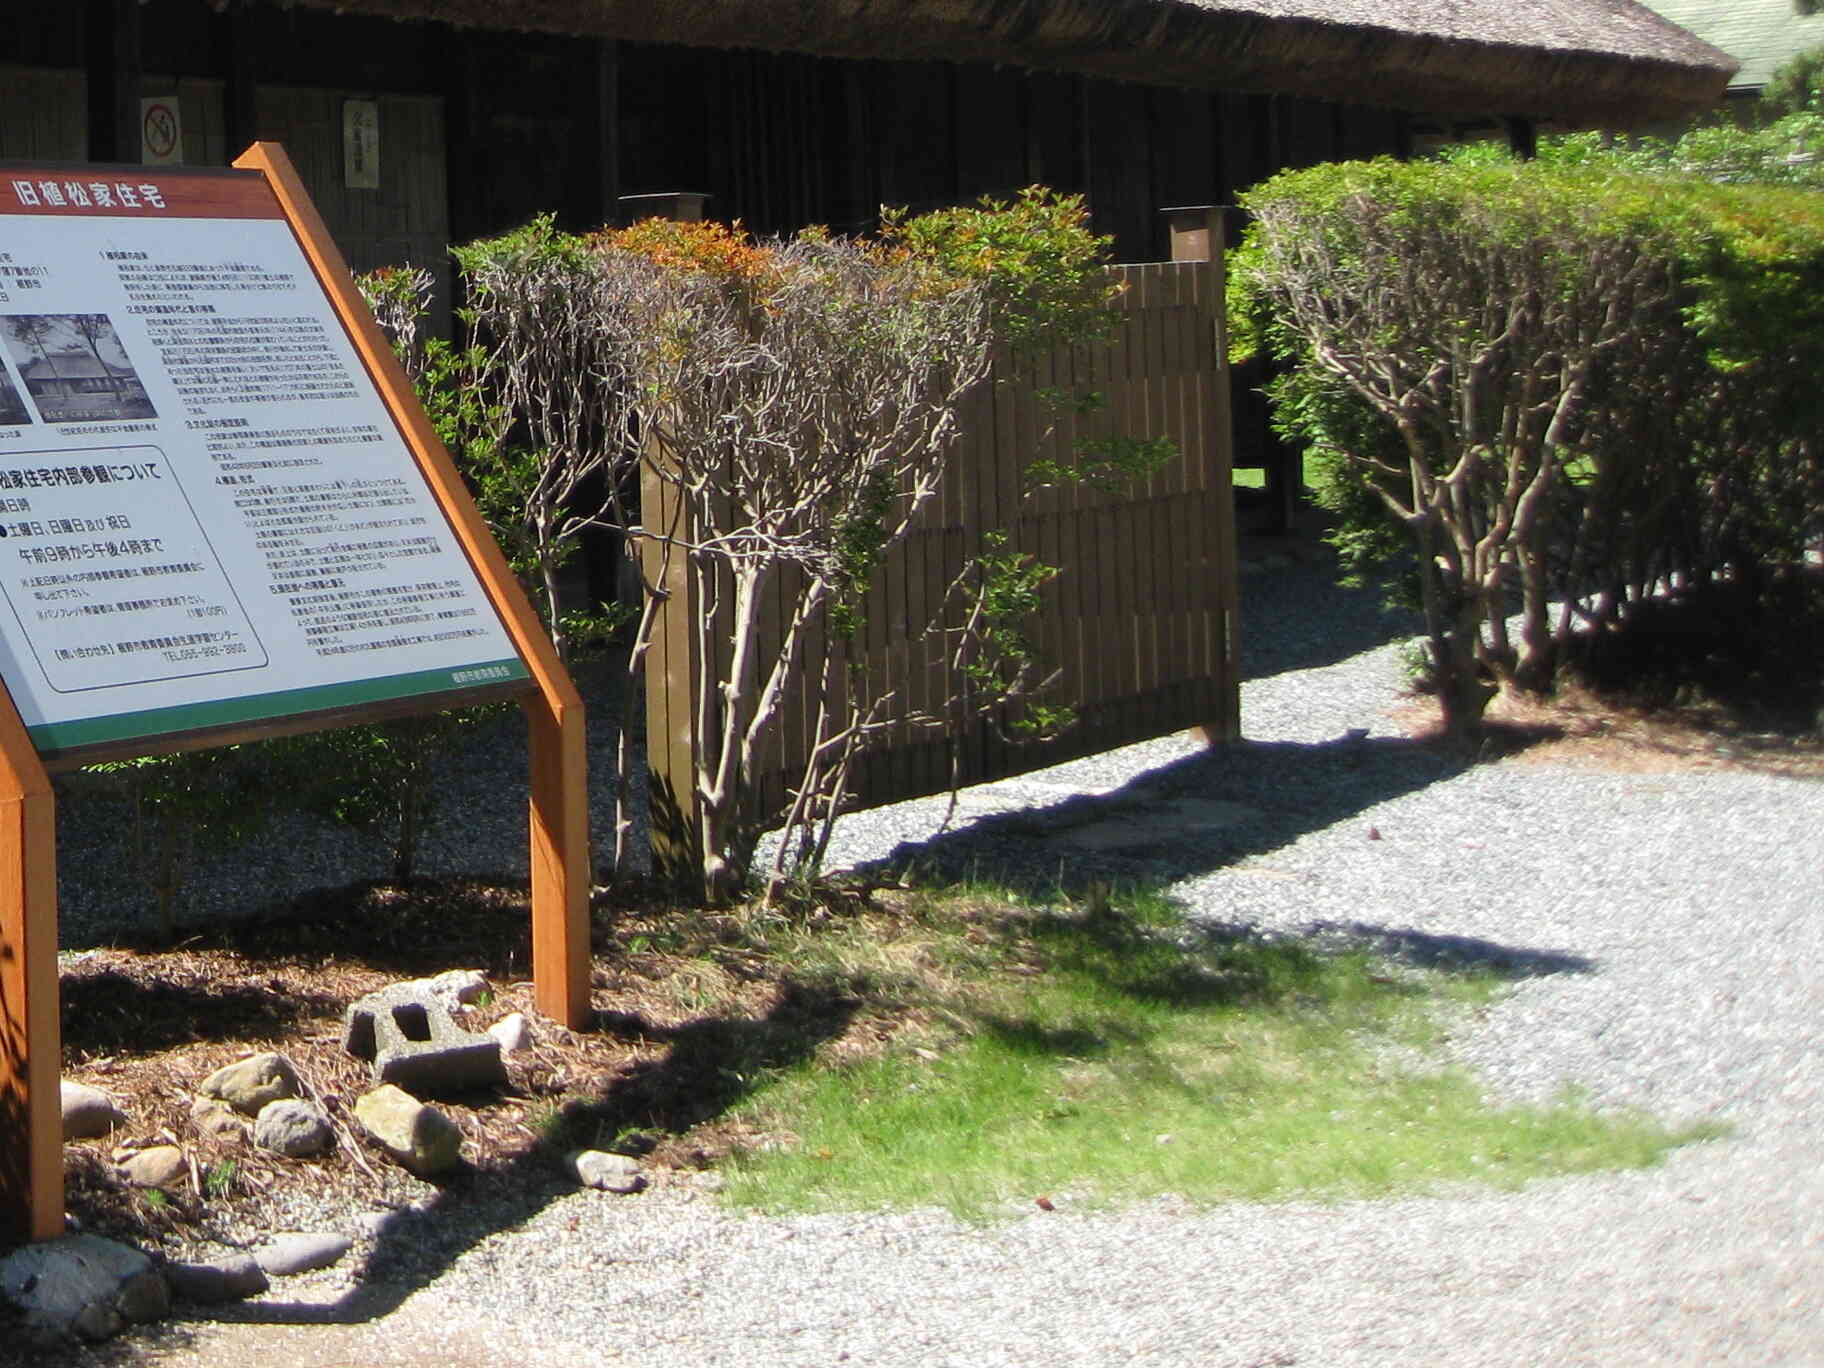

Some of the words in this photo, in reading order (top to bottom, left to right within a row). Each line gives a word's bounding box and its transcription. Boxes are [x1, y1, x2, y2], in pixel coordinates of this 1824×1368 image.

[12, 180, 167, 209] 旧植松家住宅
[19, 538, 164, 565] 午前9時から午後4時まで
